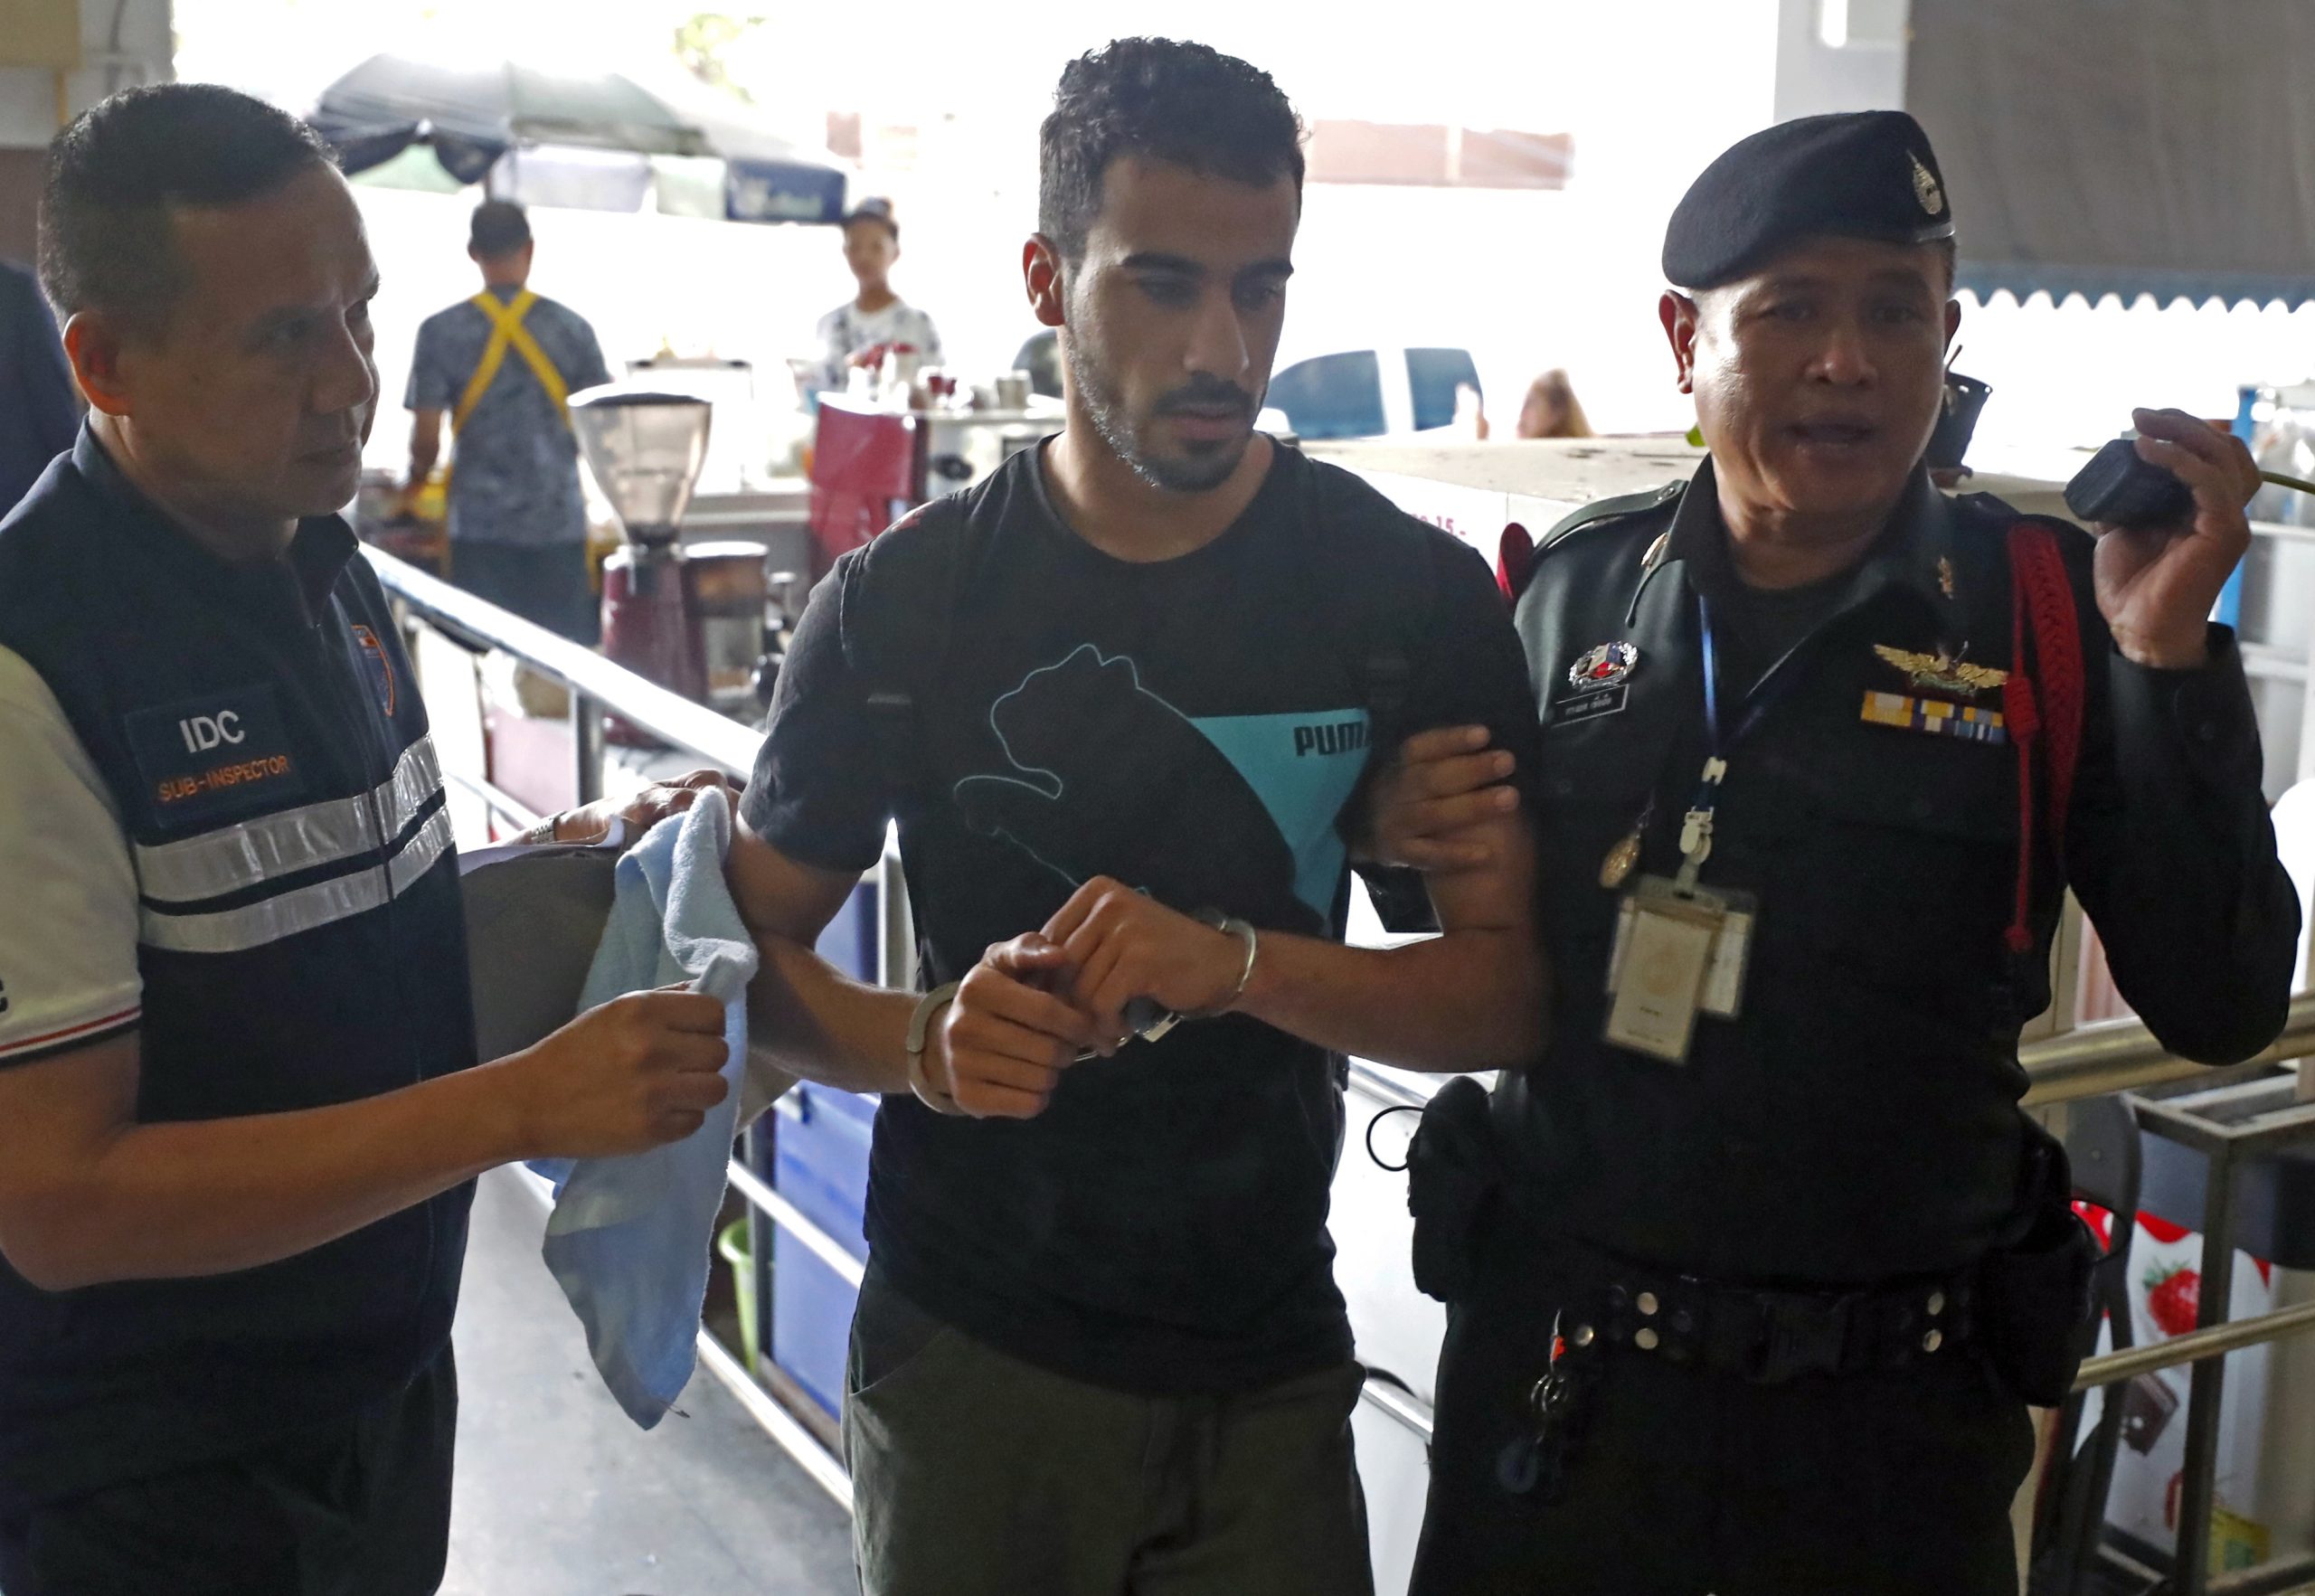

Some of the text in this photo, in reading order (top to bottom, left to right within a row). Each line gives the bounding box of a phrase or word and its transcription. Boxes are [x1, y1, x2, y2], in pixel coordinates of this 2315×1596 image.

[179, 710, 245, 753] IDC
[1293, 720, 1370, 757] PUM
[158, 755, 289, 802] SUB-INSPECTOR
